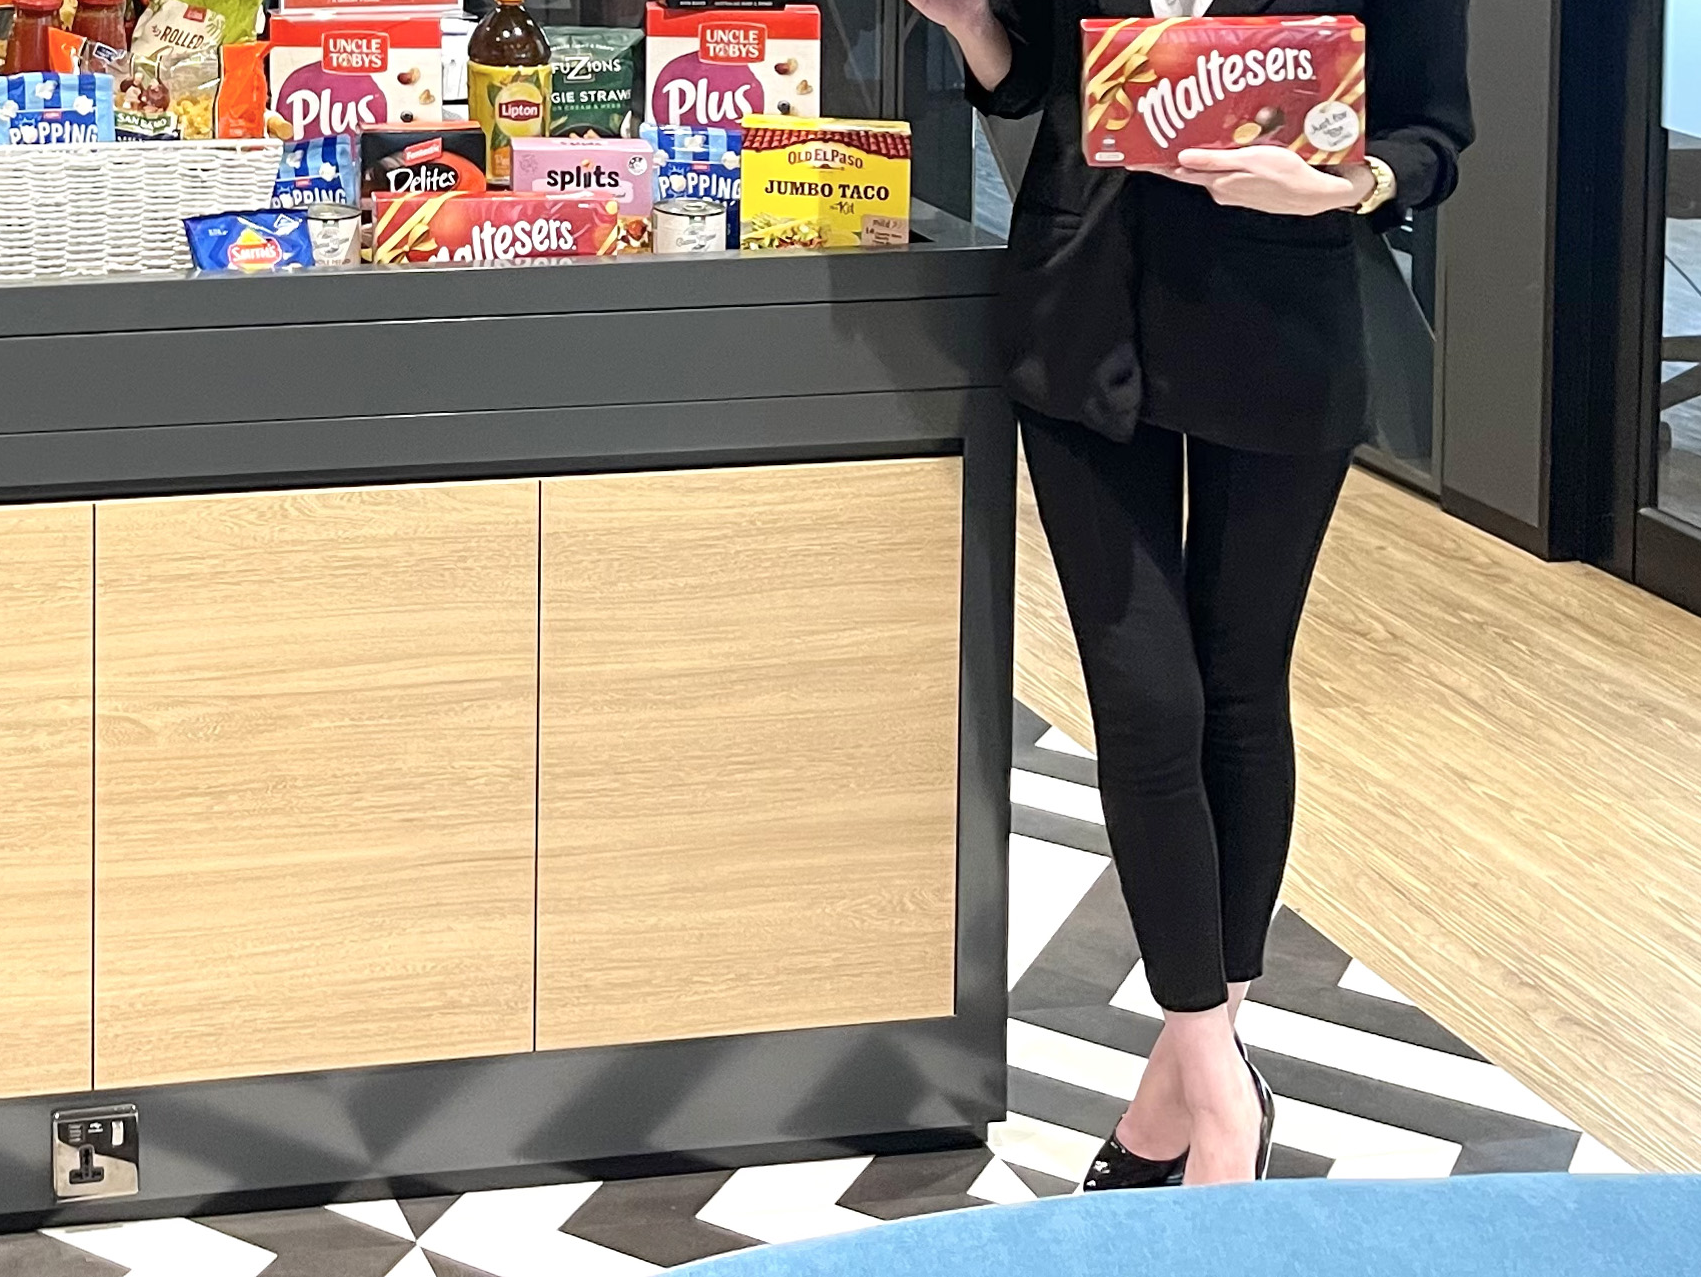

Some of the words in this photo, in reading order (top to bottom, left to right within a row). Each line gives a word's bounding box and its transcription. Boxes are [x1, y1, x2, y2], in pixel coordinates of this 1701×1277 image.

[160, 26, 204, 50] ROLLED
[329, 38, 381, 53] UNCLE
[706, 29, 758, 43] UNCLE
[329, 53, 382, 67] TOBYS
[706, 43, 759, 58] TOBYS
[551, 57, 622, 79] FUZIONS
[551, 91, 575, 103] GIE
[662, 78, 752, 125] Plus
[1137, 47, 1314, 149] Maltesers
[286, 88, 376, 141] Plus
[502, 105, 538, 117] Lipton
[9, 122, 98, 144] POPPING
[788, 150, 812, 165] OLD
[386, 165, 456, 192] Delites
[547, 159, 620, 191] splits
[765, 180, 833, 198] JUMBO
[838, 184, 890, 201] TACO
